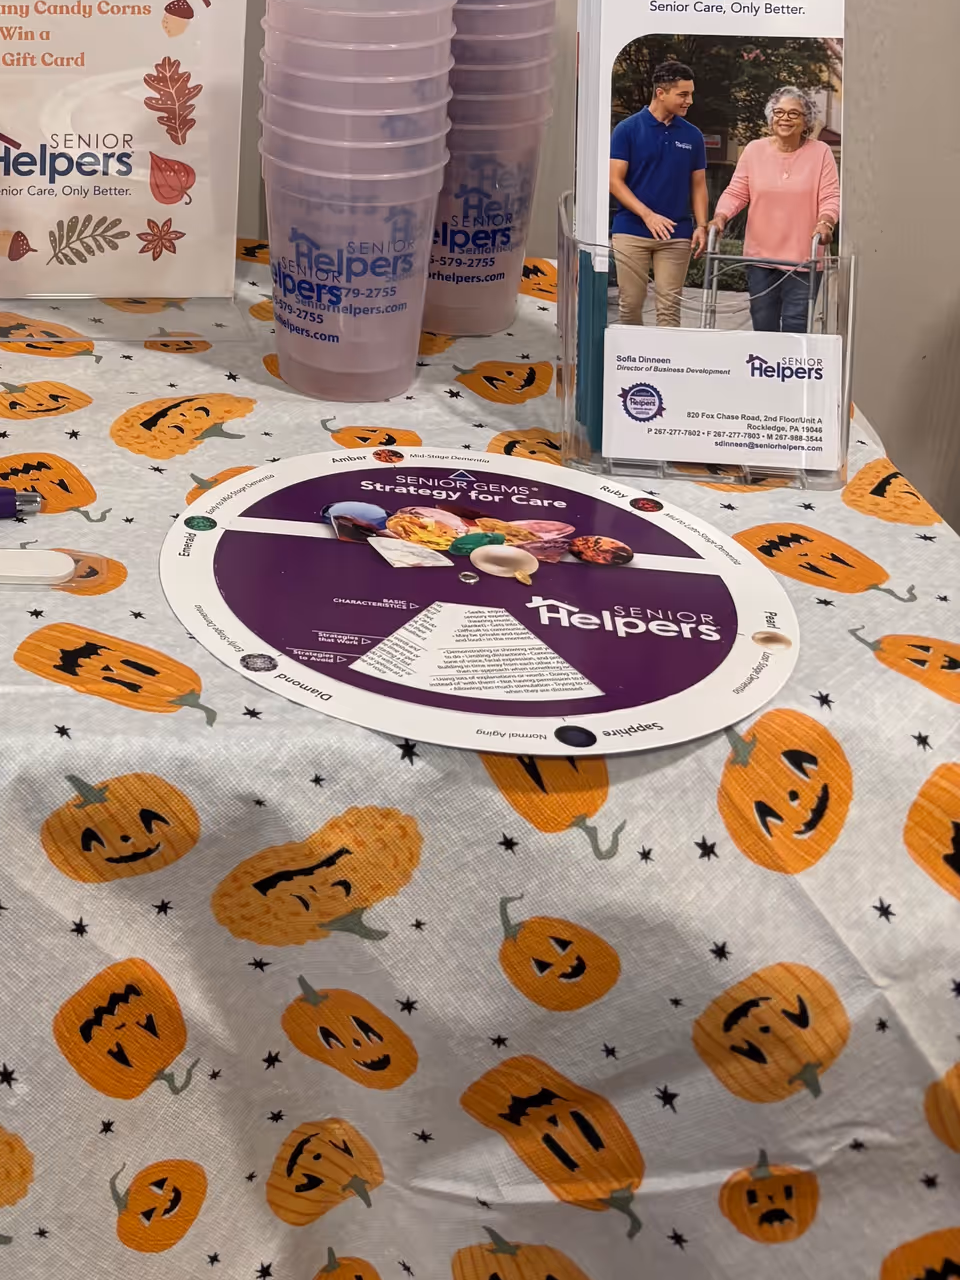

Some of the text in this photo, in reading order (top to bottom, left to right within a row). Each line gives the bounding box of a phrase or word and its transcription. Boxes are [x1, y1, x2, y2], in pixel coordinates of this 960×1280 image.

[34, 0, 92, 18] Candy
[97, 0, 152, 16] Corns
[649, 1, 805, 16] Senior Care, Only Better.
[39, 29, 51, 41] a
[1, 52, 37, 67] Gift
[40, 52, 85, 67] Card
[50, 133, 134, 149] SENIOR
[27, 185, 58, 197] Care,
[62, 185, 89, 198] Only
[93, 186, 132, 196] Better.
[451, 213, 513, 228] SENIOR
[347, 239, 416, 255] SENIOR
[296, 241, 414, 283] Helpers
[282, 257, 341, 283] SENIOR
[639, 356, 671, 364] Dinneen
[782, 357, 823, 367] SENIOR
[686, 367, 730, 376] Development
[751, 361, 823, 382] Helpers
[741, 414, 762, 422] Road,
[747, 423, 787, 433] Rockledge,
[714, 440, 823, 452] sdinneen@seniorhelpers.com
[331, 455, 367, 464] Amber
[450, 455, 490, 464] Dementia
[395, 475, 467, 489] SENIOR
[360, 480, 567, 509] Strategy for Care
[600, 485, 629, 498] Ruby
[178, 532, 197, 557] Emerald
[333, 597, 407, 609] CHARACTERISTICS
[614, 606, 714, 624] SENIOR
[764, 611, 781, 630] Pearl
[539, 606, 721, 641] Helpers
[318, 632, 359, 640] Strategies
[293, 650, 334, 658] Strategies
[274, 673, 333, 701] Diamond
[476, 728, 547, 740] Normal Aging
[602, 722, 665, 737] Sapphire
